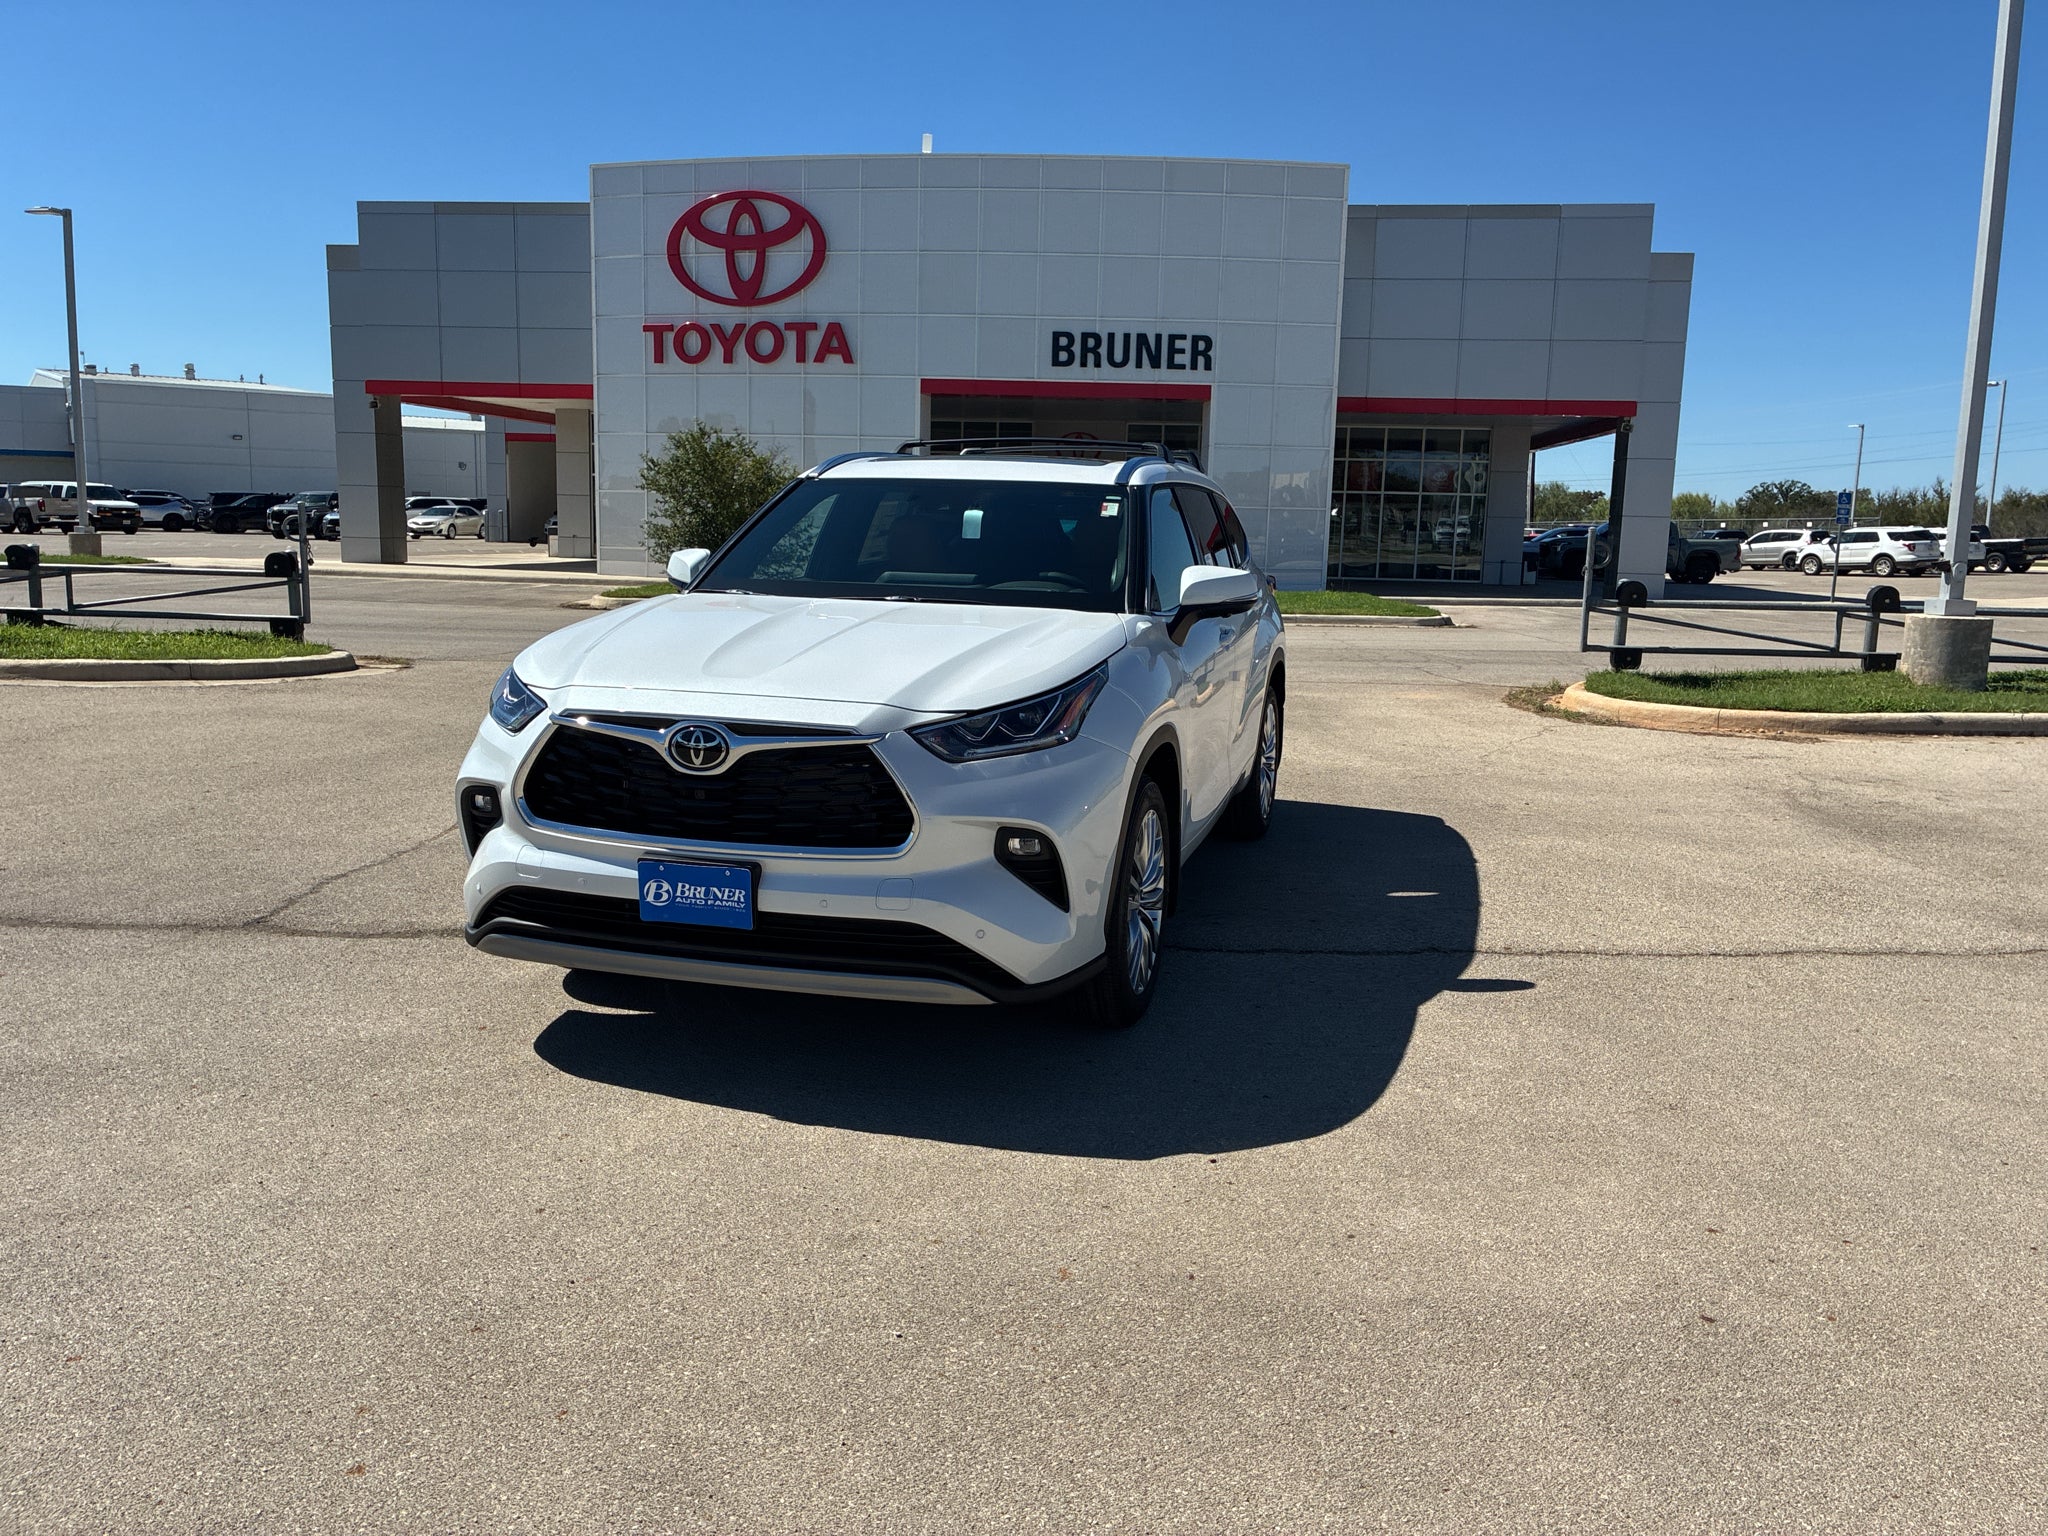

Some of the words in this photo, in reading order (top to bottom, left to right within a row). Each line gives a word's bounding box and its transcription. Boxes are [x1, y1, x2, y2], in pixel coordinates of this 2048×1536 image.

[642, 321, 854, 364] TOYOTA
[1051, 331, 1213, 371] BRUNER
[675, 882, 746, 903] BRUNER
[675, 897, 705, 905] AUTO
[707, 899, 746, 908] FAMILY
